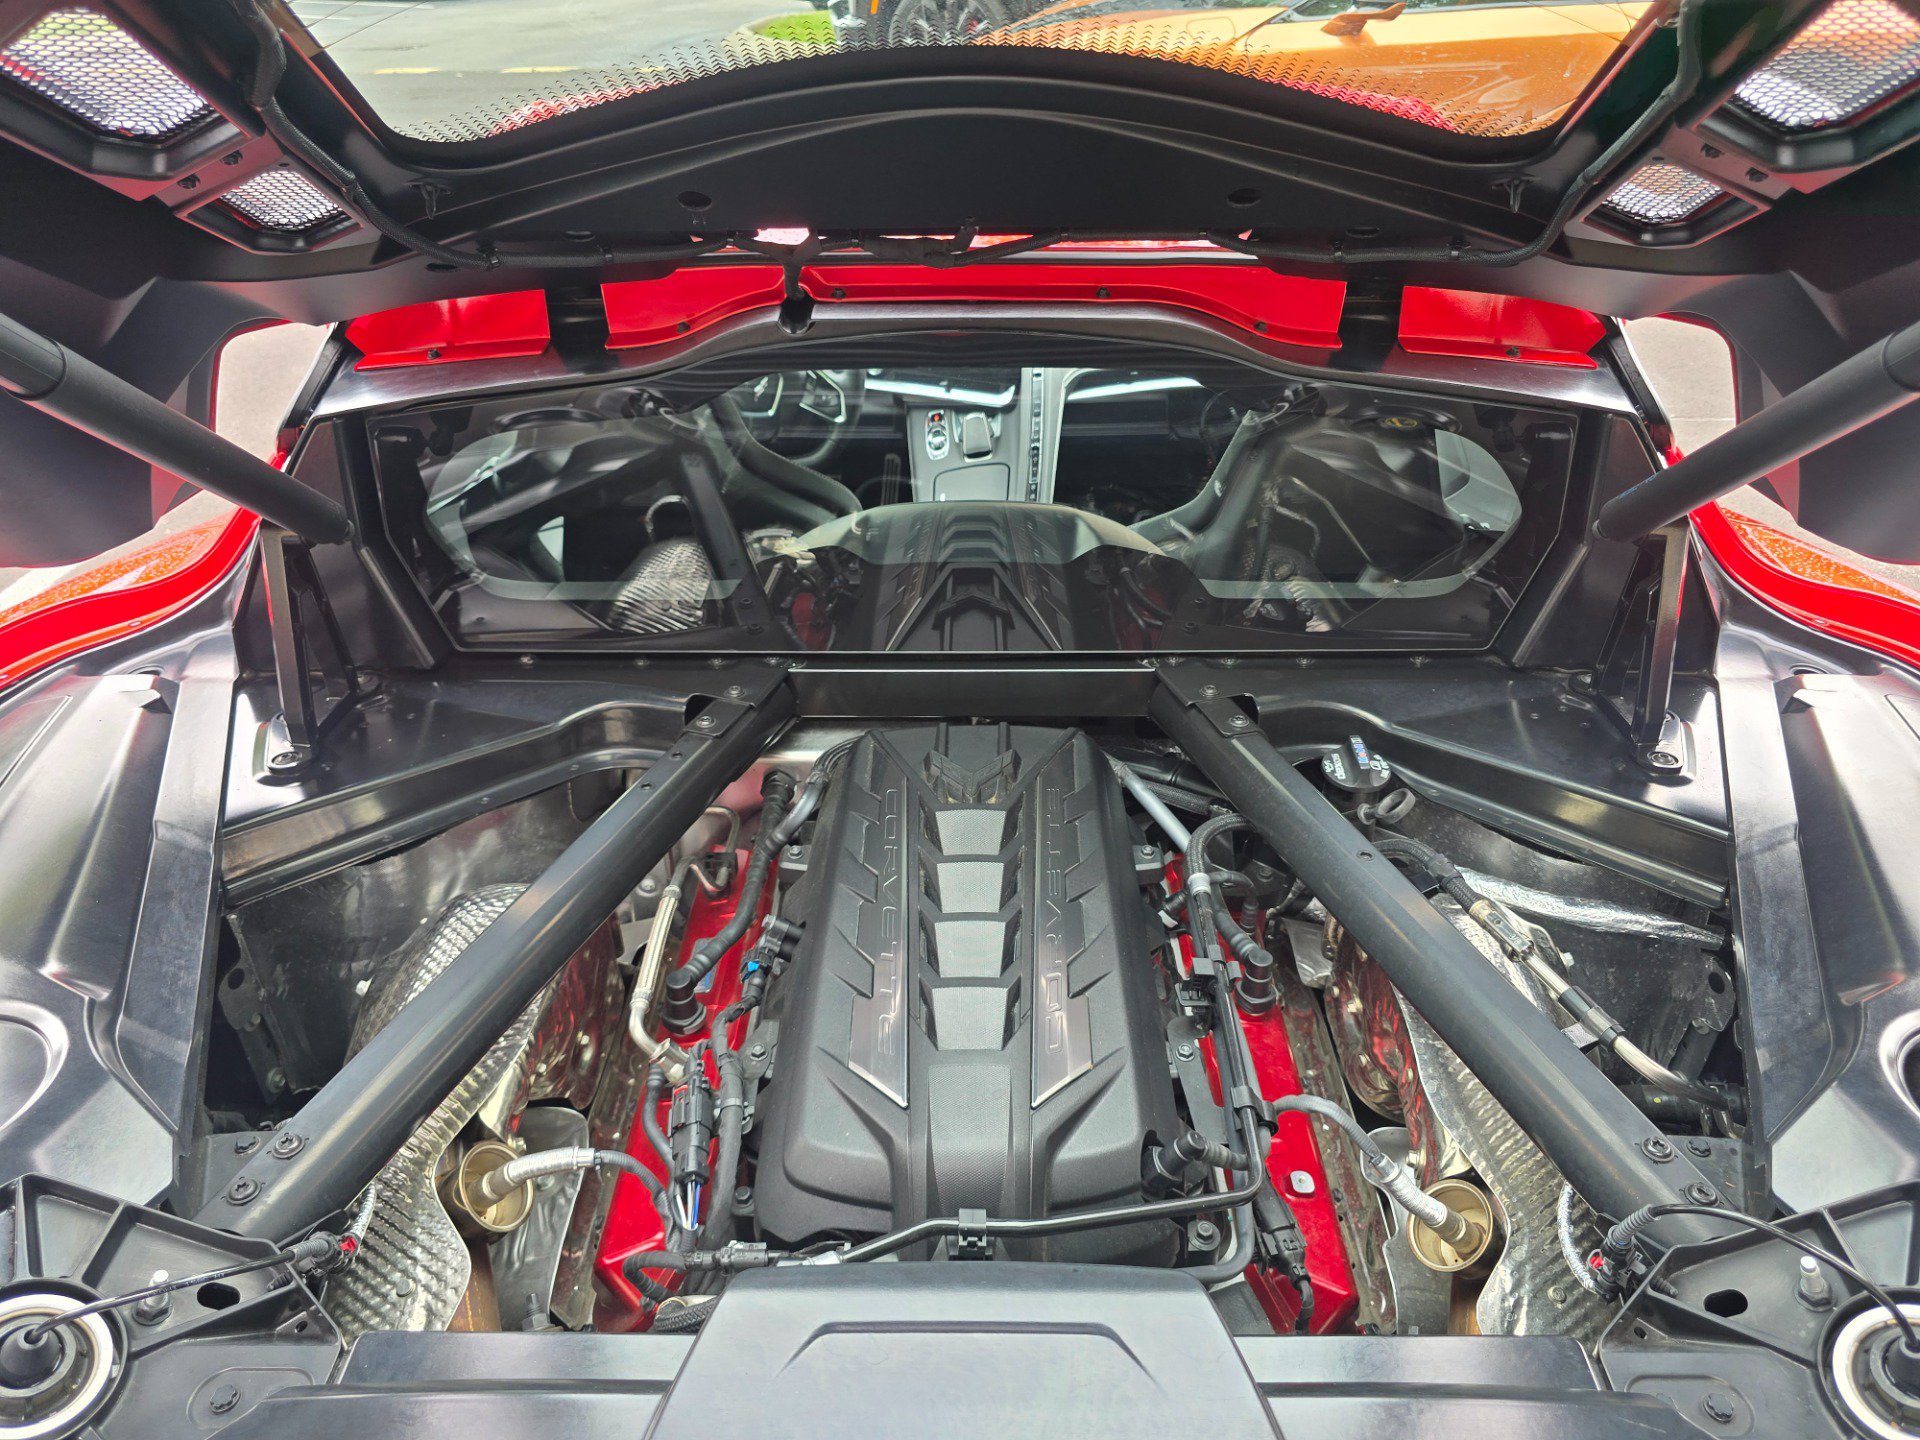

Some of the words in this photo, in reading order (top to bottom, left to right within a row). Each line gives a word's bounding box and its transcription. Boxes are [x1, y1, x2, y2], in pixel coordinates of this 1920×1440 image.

[1331, 753, 1346, 780] dexos
[878, 789, 898, 1055] CORVETTE
[1045, 788, 1062, 1053] CORVETTE
